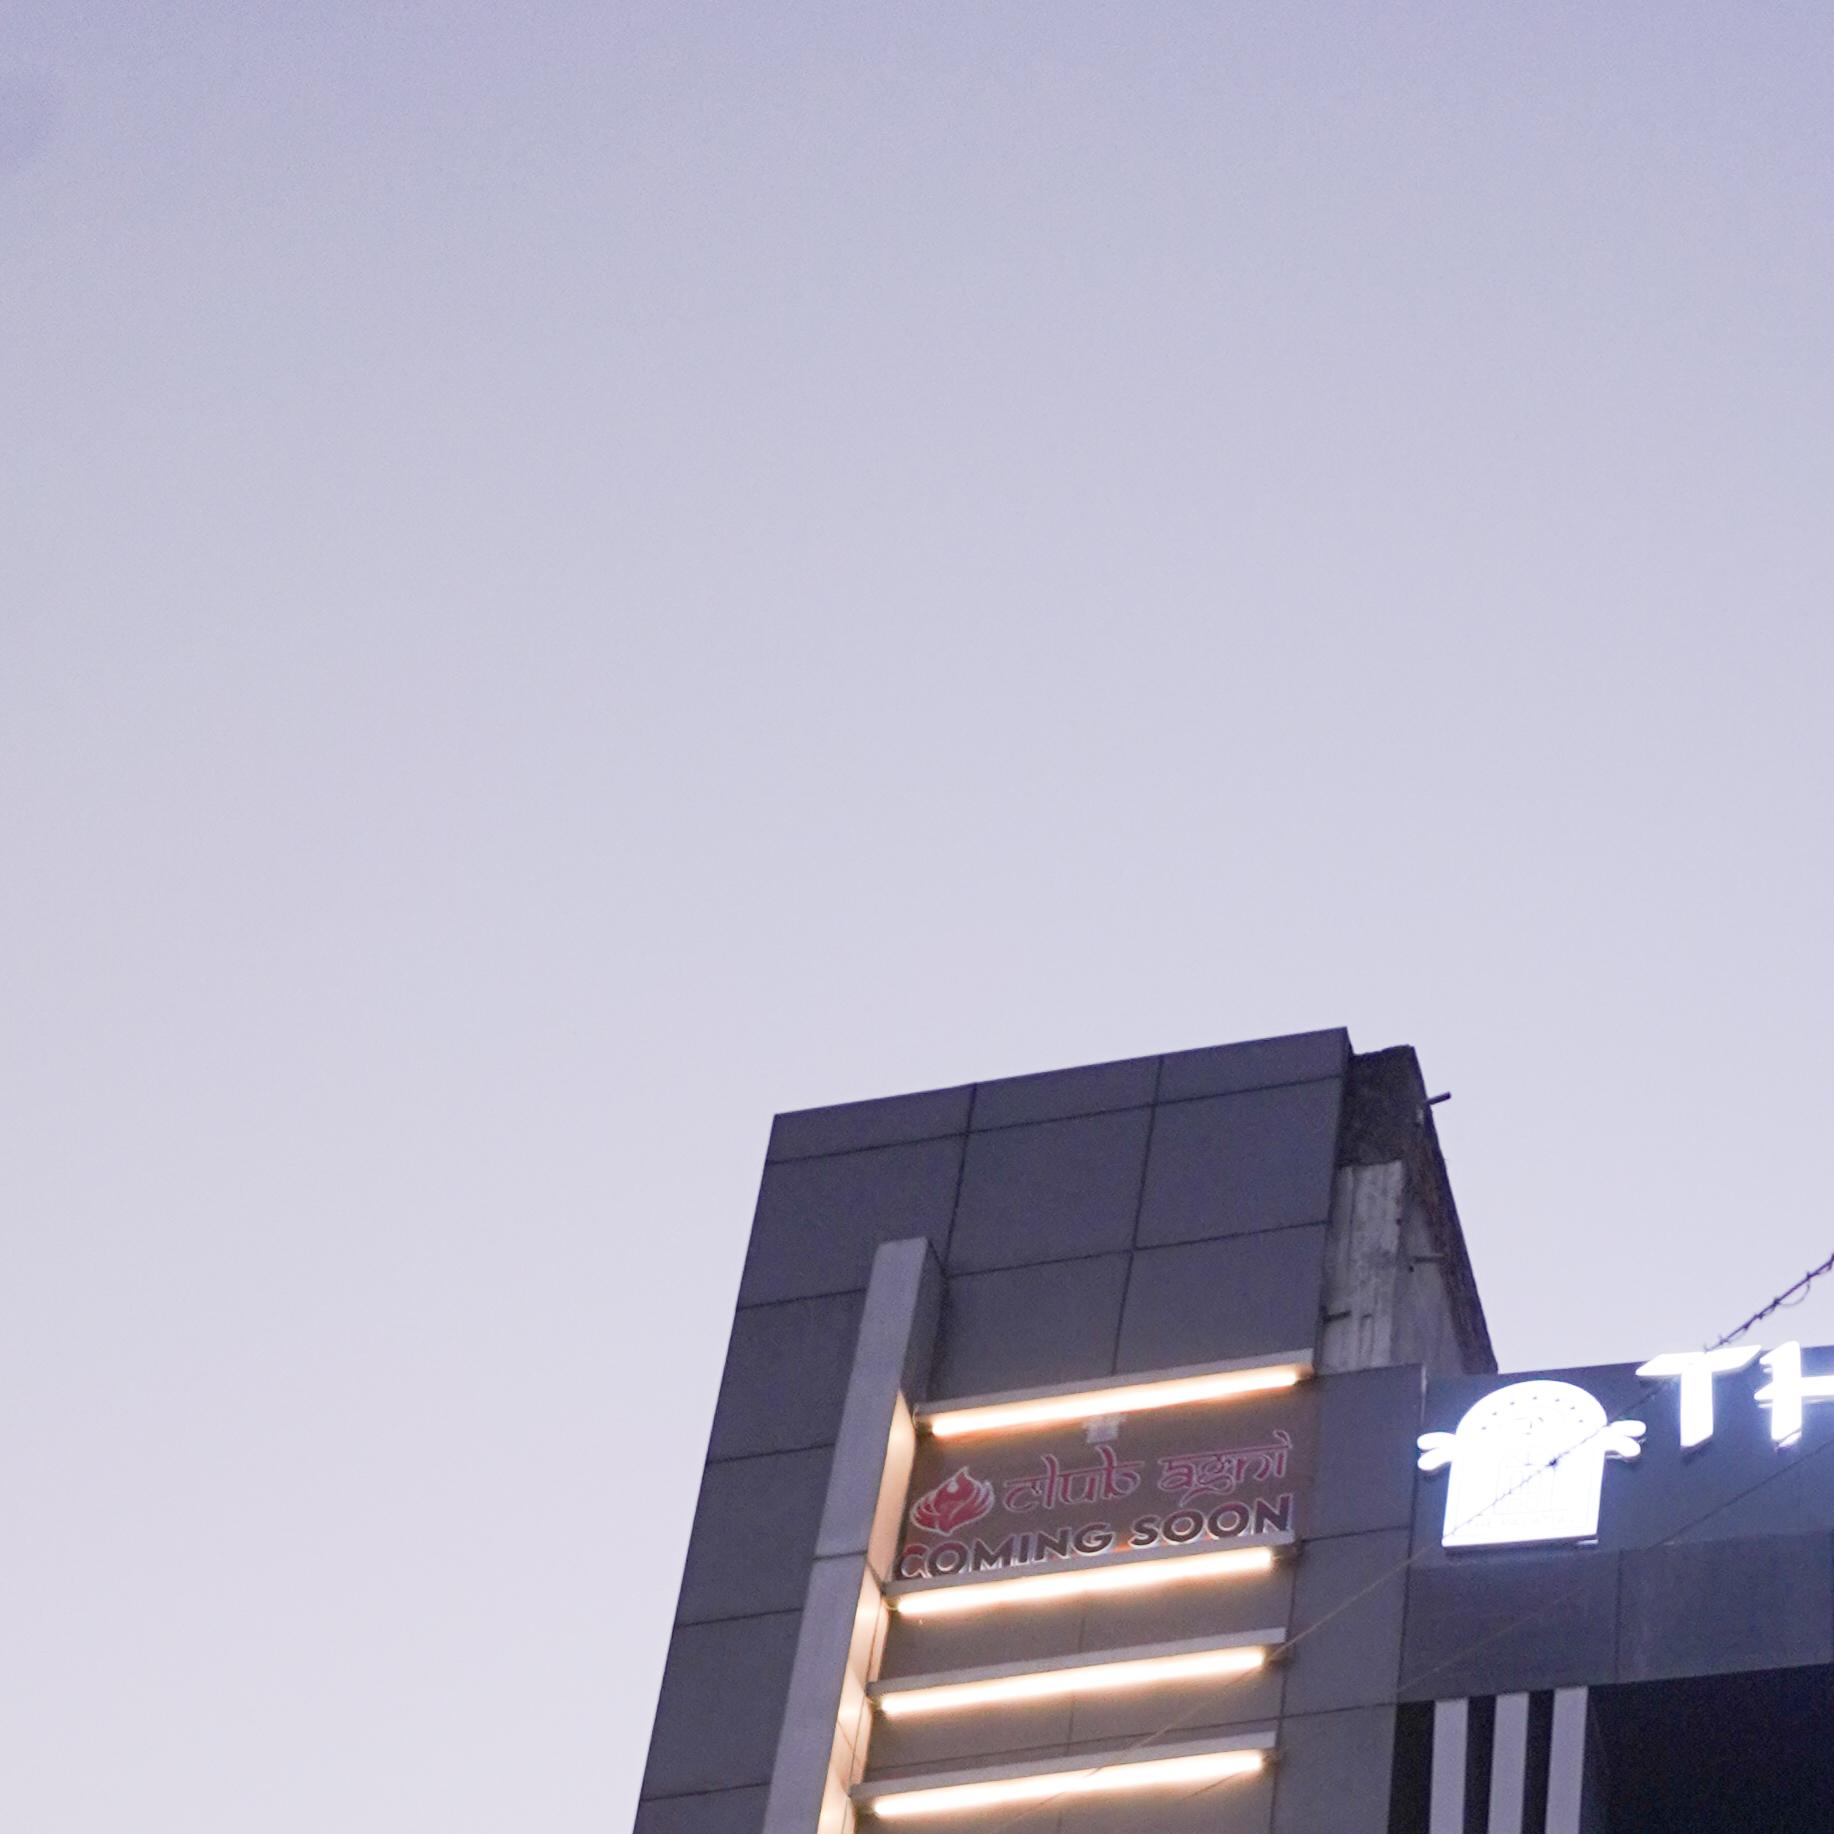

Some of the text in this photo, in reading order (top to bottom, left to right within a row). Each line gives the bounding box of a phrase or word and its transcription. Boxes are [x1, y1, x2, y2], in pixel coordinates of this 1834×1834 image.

[1003, 1445, 1145, 1512] club
[901, 1494, 1293, 1578] COMING SOON
